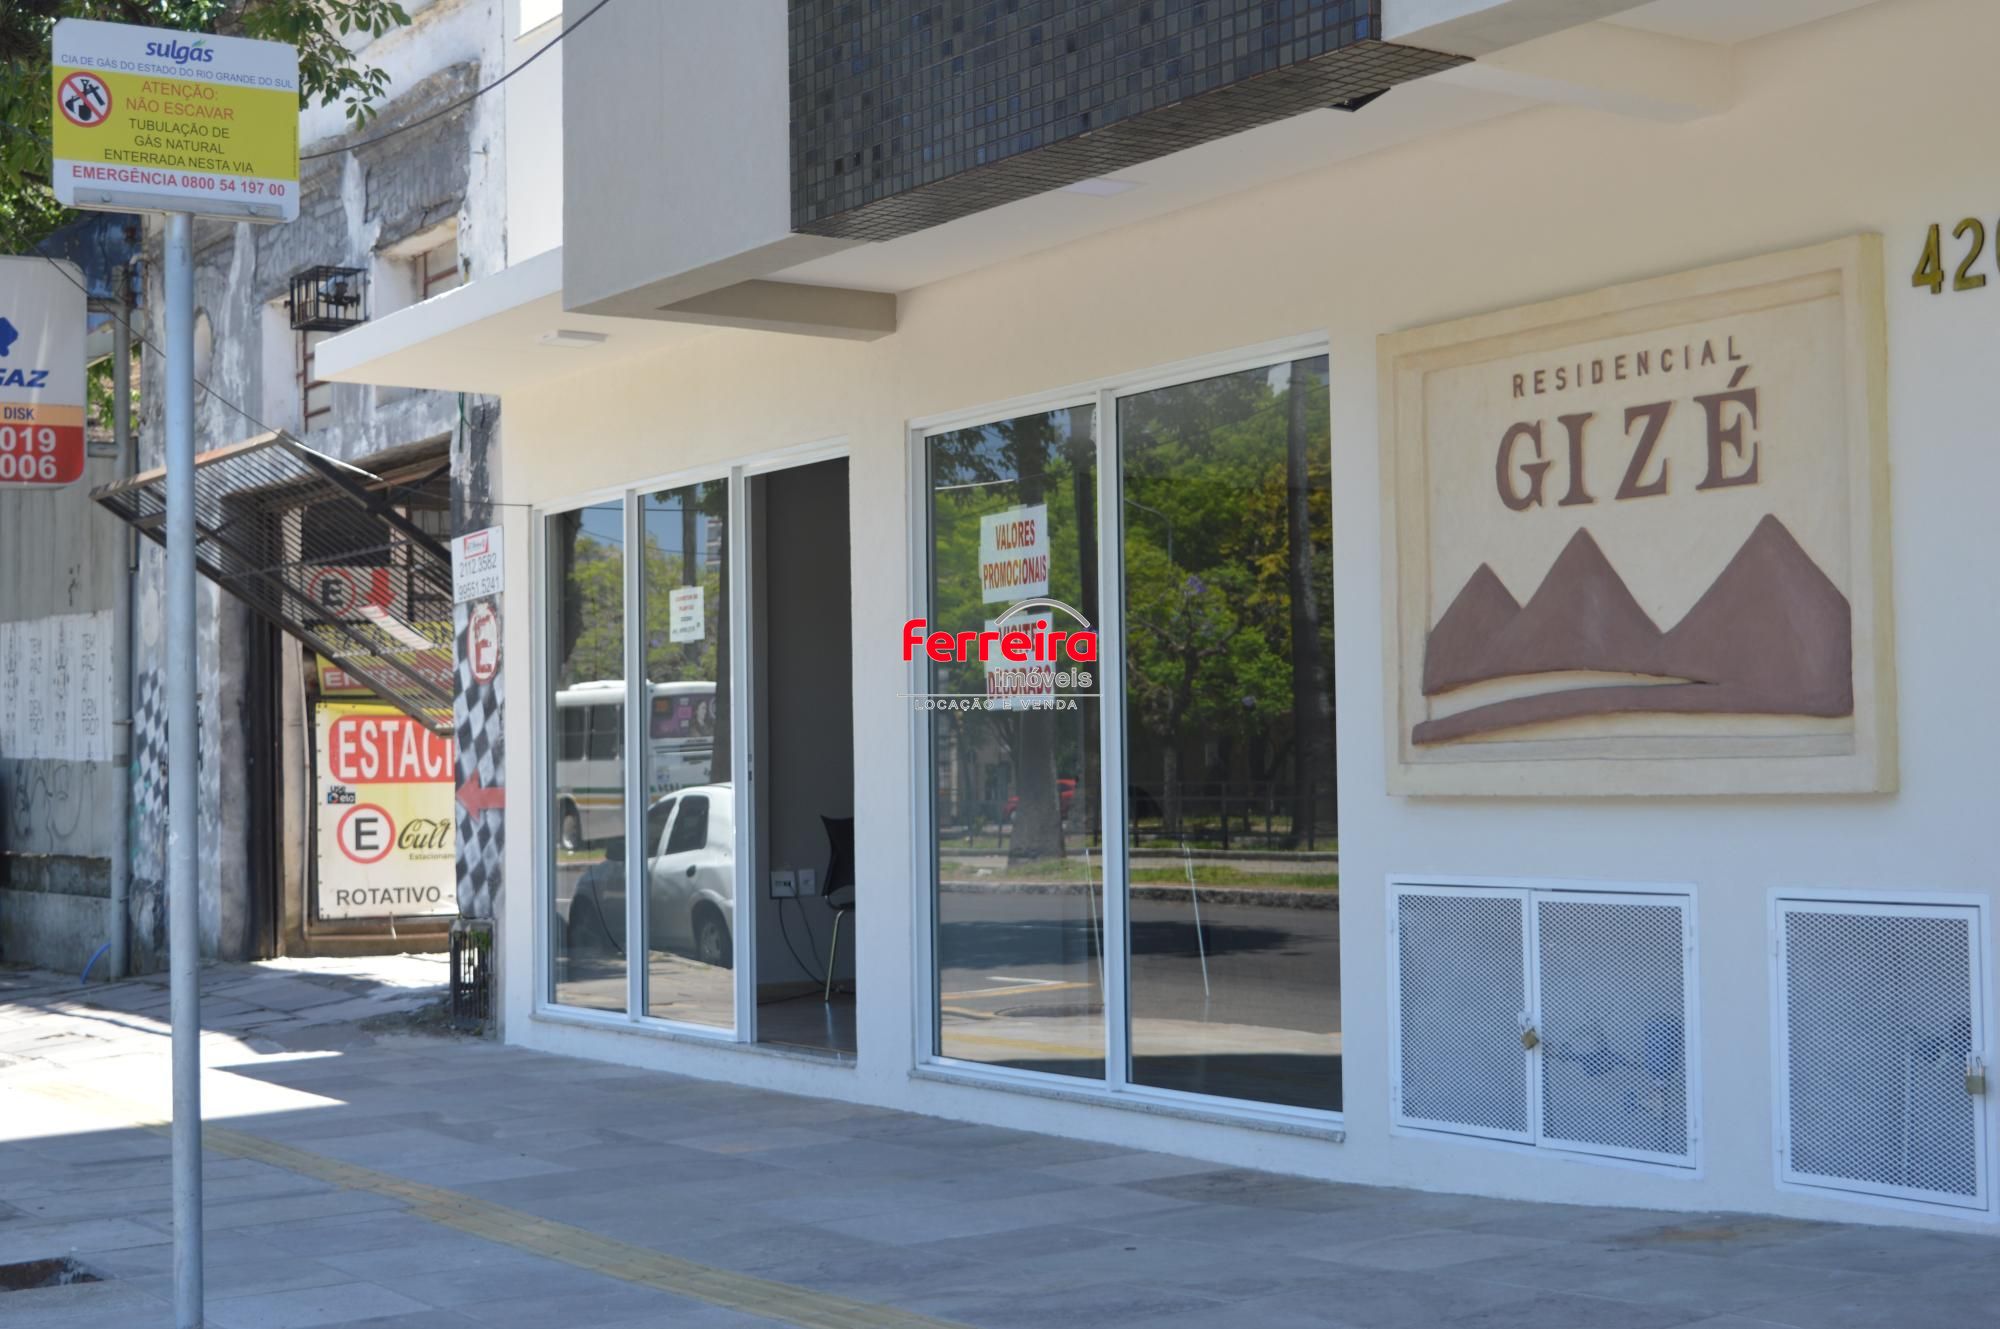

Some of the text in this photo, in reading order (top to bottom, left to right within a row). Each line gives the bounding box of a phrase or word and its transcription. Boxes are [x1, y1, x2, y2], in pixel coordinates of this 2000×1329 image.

[61, 54, 293, 89] CIA DE GÁS DO ESTADO DO RIO GRANDE DO SUL
[141, 80, 219, 102] ATENÇÃO:
[126, 97, 235, 121] NÃO ESCAVAR
[129, 117, 230, 139] TUBULAÇÃO DE
[134, 134, 225, 155] GÁS NATURAL
[104, 148, 254, 174] ENTERRADA NESTA VIA
[72, 164, 286, 197] EMERGÊNCIA 0800 54 197 00
[1911, 217, 2000, 294] 42
[0, 369, 49, 388] AZ
[1513, 335, 1742, 399] RESIDENCIAL
[4, 407, 34, 421] DISK
[0, 426, 56, 453] 019
[1495, 365, 1760, 512] GIZÉ
[0, 454, 57, 479] 006
[995, 519, 1036, 550] VALORES
[983, 555, 1047, 590] PROMOCIONAIS
[355, 817, 380, 851] E
[336, 886, 441, 906] ROTATIVO
